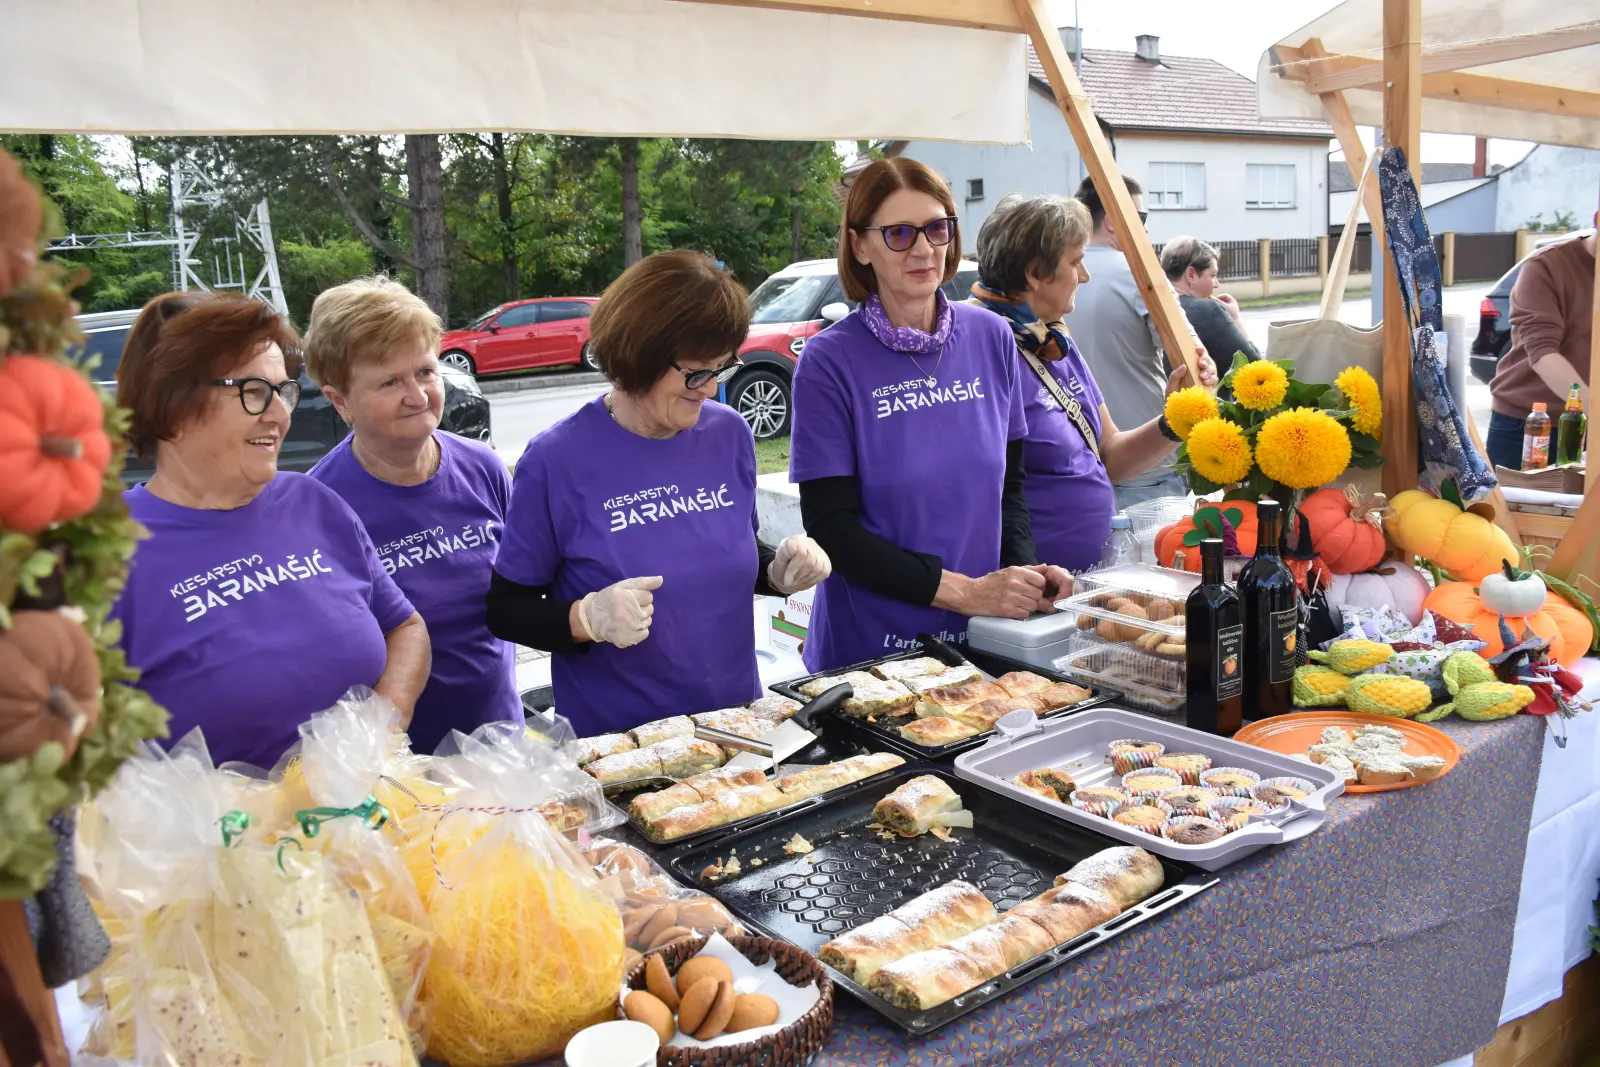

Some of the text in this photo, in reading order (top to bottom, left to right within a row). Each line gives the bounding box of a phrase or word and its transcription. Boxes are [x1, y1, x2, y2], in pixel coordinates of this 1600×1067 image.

[872, 378, 937, 398] KLESARSTVO
[877, 377, 984, 419] BARANAŠIĆ
[603, 484, 679, 511] KLESARSTVO
[610, 483, 734, 533] BARANAŠIĆ
[381, 520, 495, 576] BARANAŠIĆ
[170, 554, 263, 598] KLESARSTVO
[183, 549, 332, 623] BARANAŠIĆ
